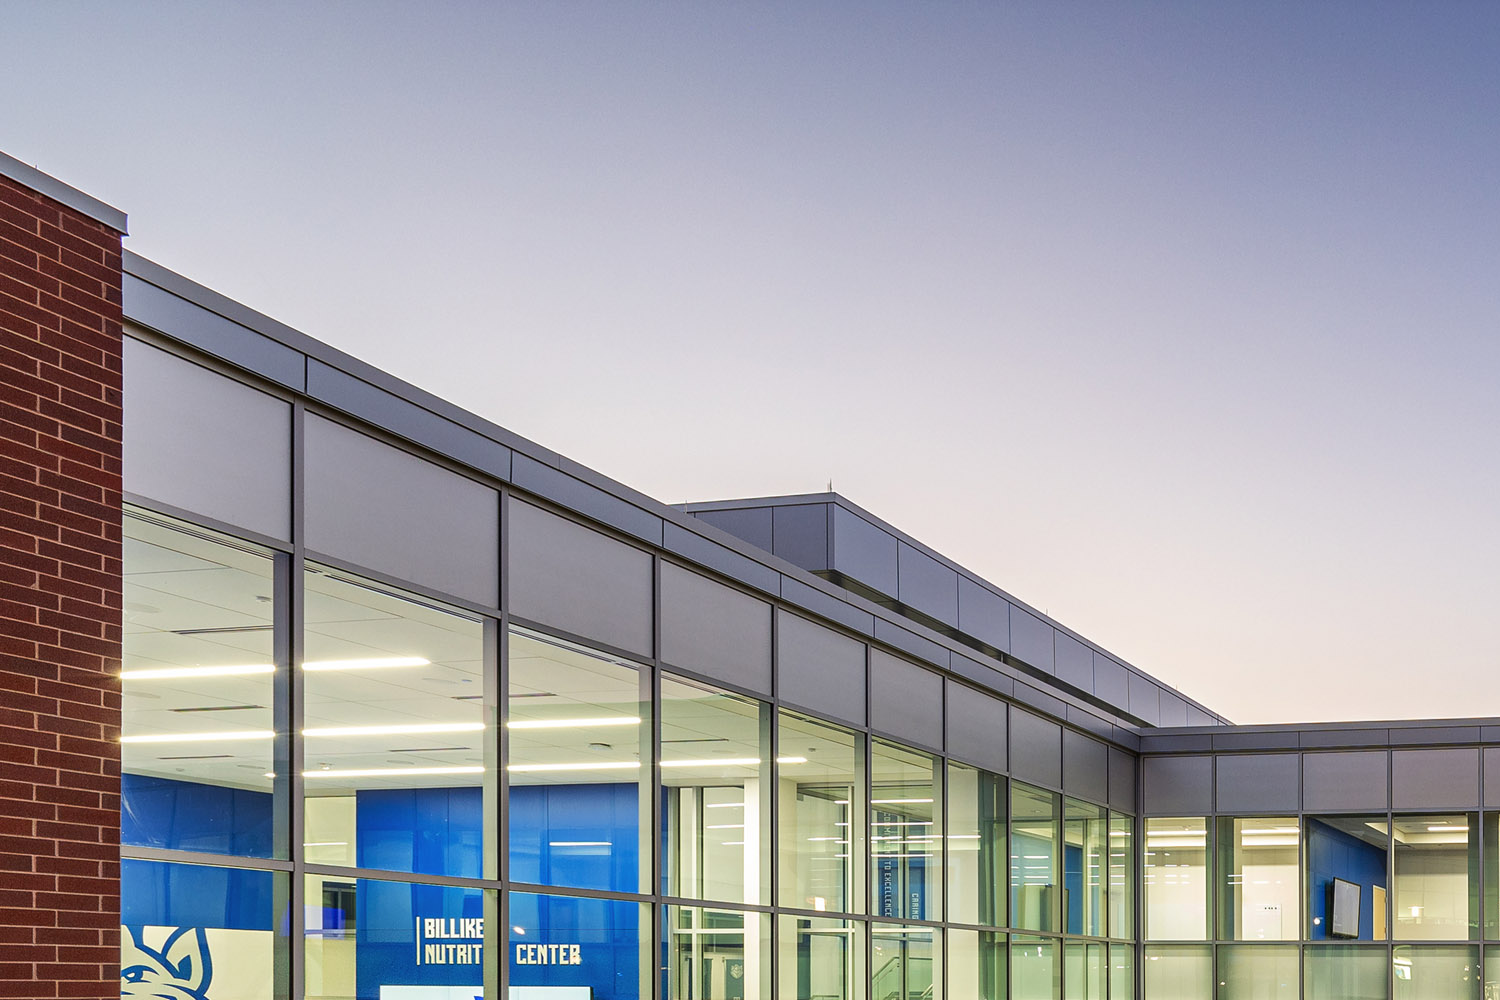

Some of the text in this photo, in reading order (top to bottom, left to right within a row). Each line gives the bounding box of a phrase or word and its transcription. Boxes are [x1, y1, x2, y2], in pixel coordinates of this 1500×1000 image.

[424, 918, 484, 939] BILLIKE
[424, 944, 581, 965] NUTRIT CENTER
